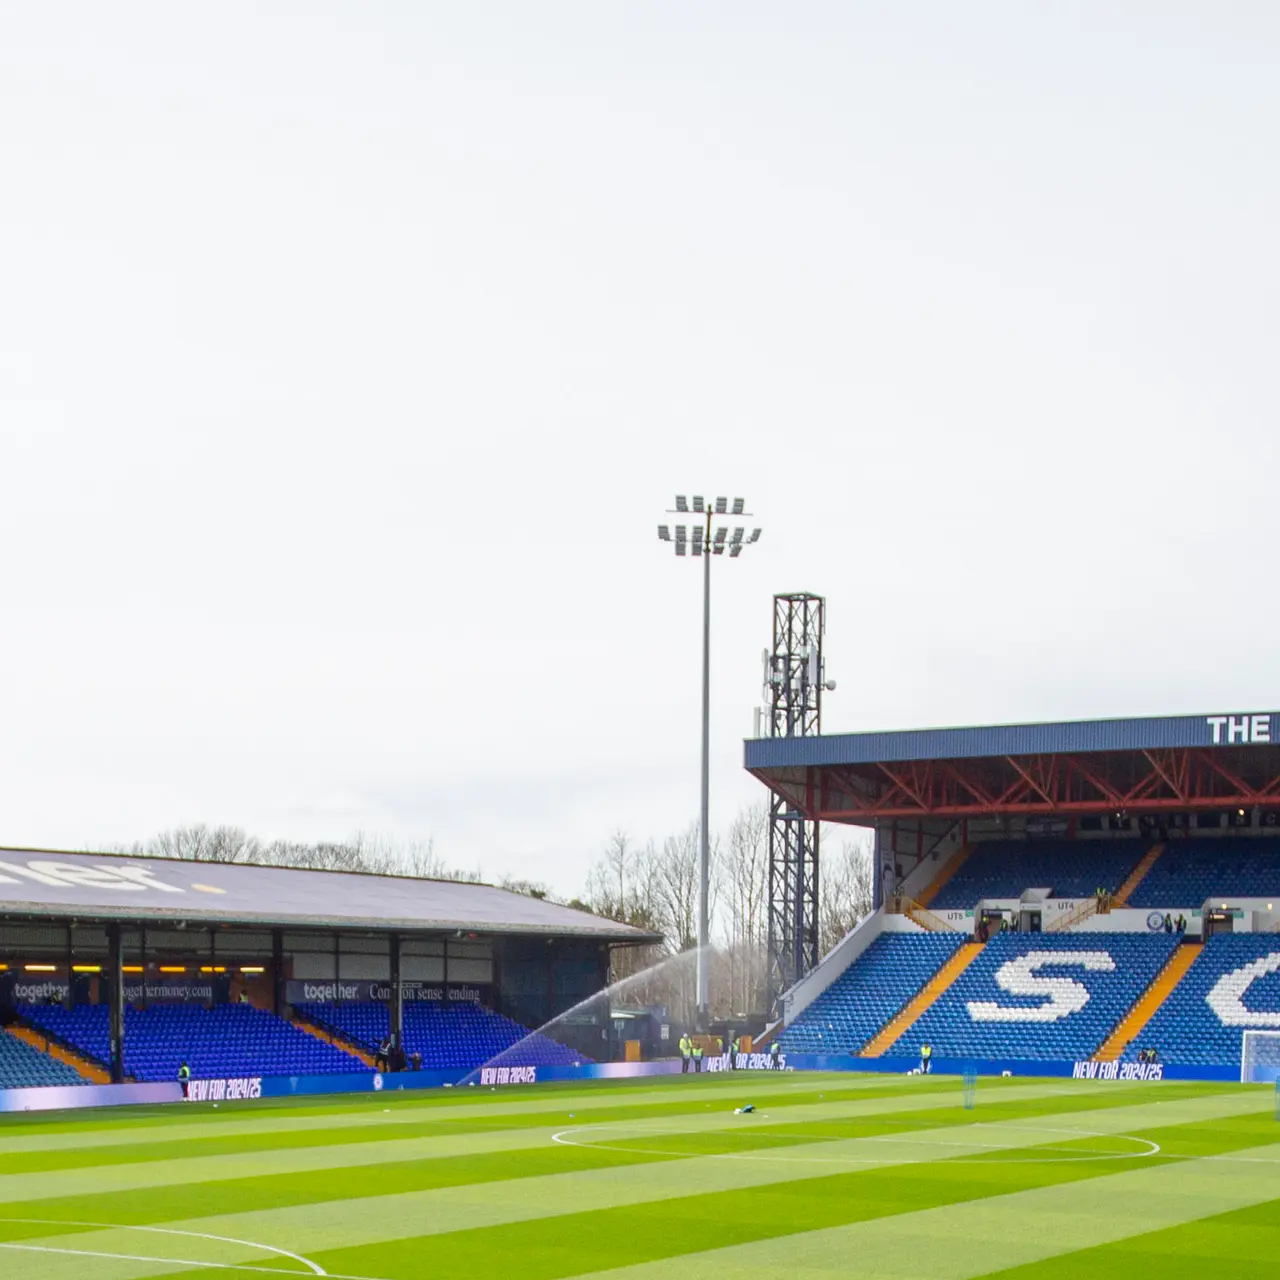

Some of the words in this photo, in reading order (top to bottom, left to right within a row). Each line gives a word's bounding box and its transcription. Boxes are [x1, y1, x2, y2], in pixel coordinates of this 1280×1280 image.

[1207, 715, 1270, 743] THE
[1058, 901, 1075, 910] UT4
[122, 984, 212, 1002] ogethermoney.com
[370, 983, 415, 1000] Comon
[967, 951, 1116, 1022] S
[734, 1054, 749, 1070] OR
[749, 1055, 787, 1071] 2024/5
[1072, 1061, 1098, 1079] NEW
[1098, 1061, 1119, 1080] FOR
[1119, 1063, 1164, 1081] 2024/25
[481, 1067, 497, 1085] NEW
[497, 1066, 510, 1084] FOR
[510, 1066, 536, 1083] 2024/25
[187, 1080, 208, 1102] NEW
[208, 1079, 226, 1101] FOR
[226, 1077, 262, 1100] 2024/25
